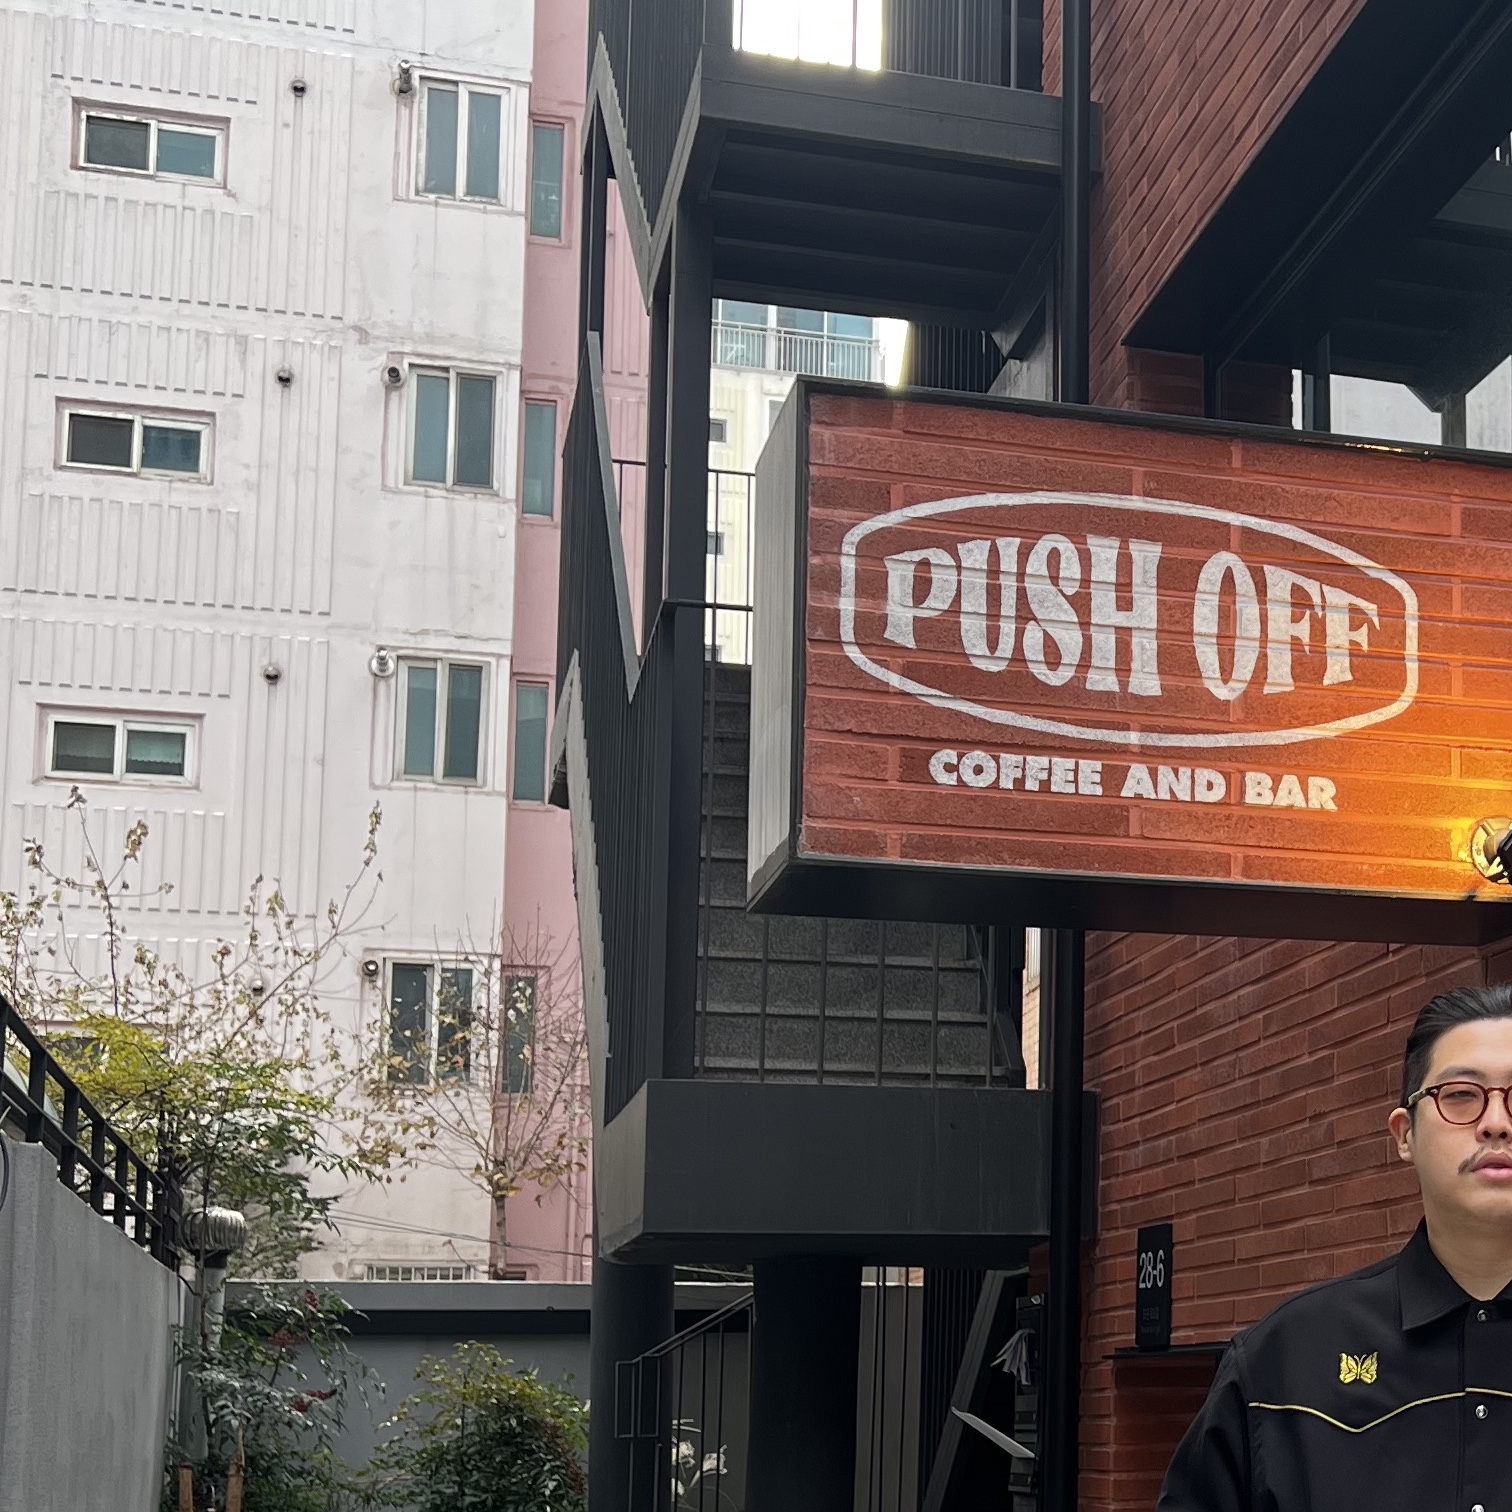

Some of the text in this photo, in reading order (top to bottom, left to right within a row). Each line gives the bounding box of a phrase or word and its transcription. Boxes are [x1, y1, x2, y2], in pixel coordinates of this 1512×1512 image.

[883, 533, 1381, 701] PUSH OFF
[929, 748, 1338, 812] COFFEE AND BAR
[1139, 1249, 1165, 1288] 28-6
